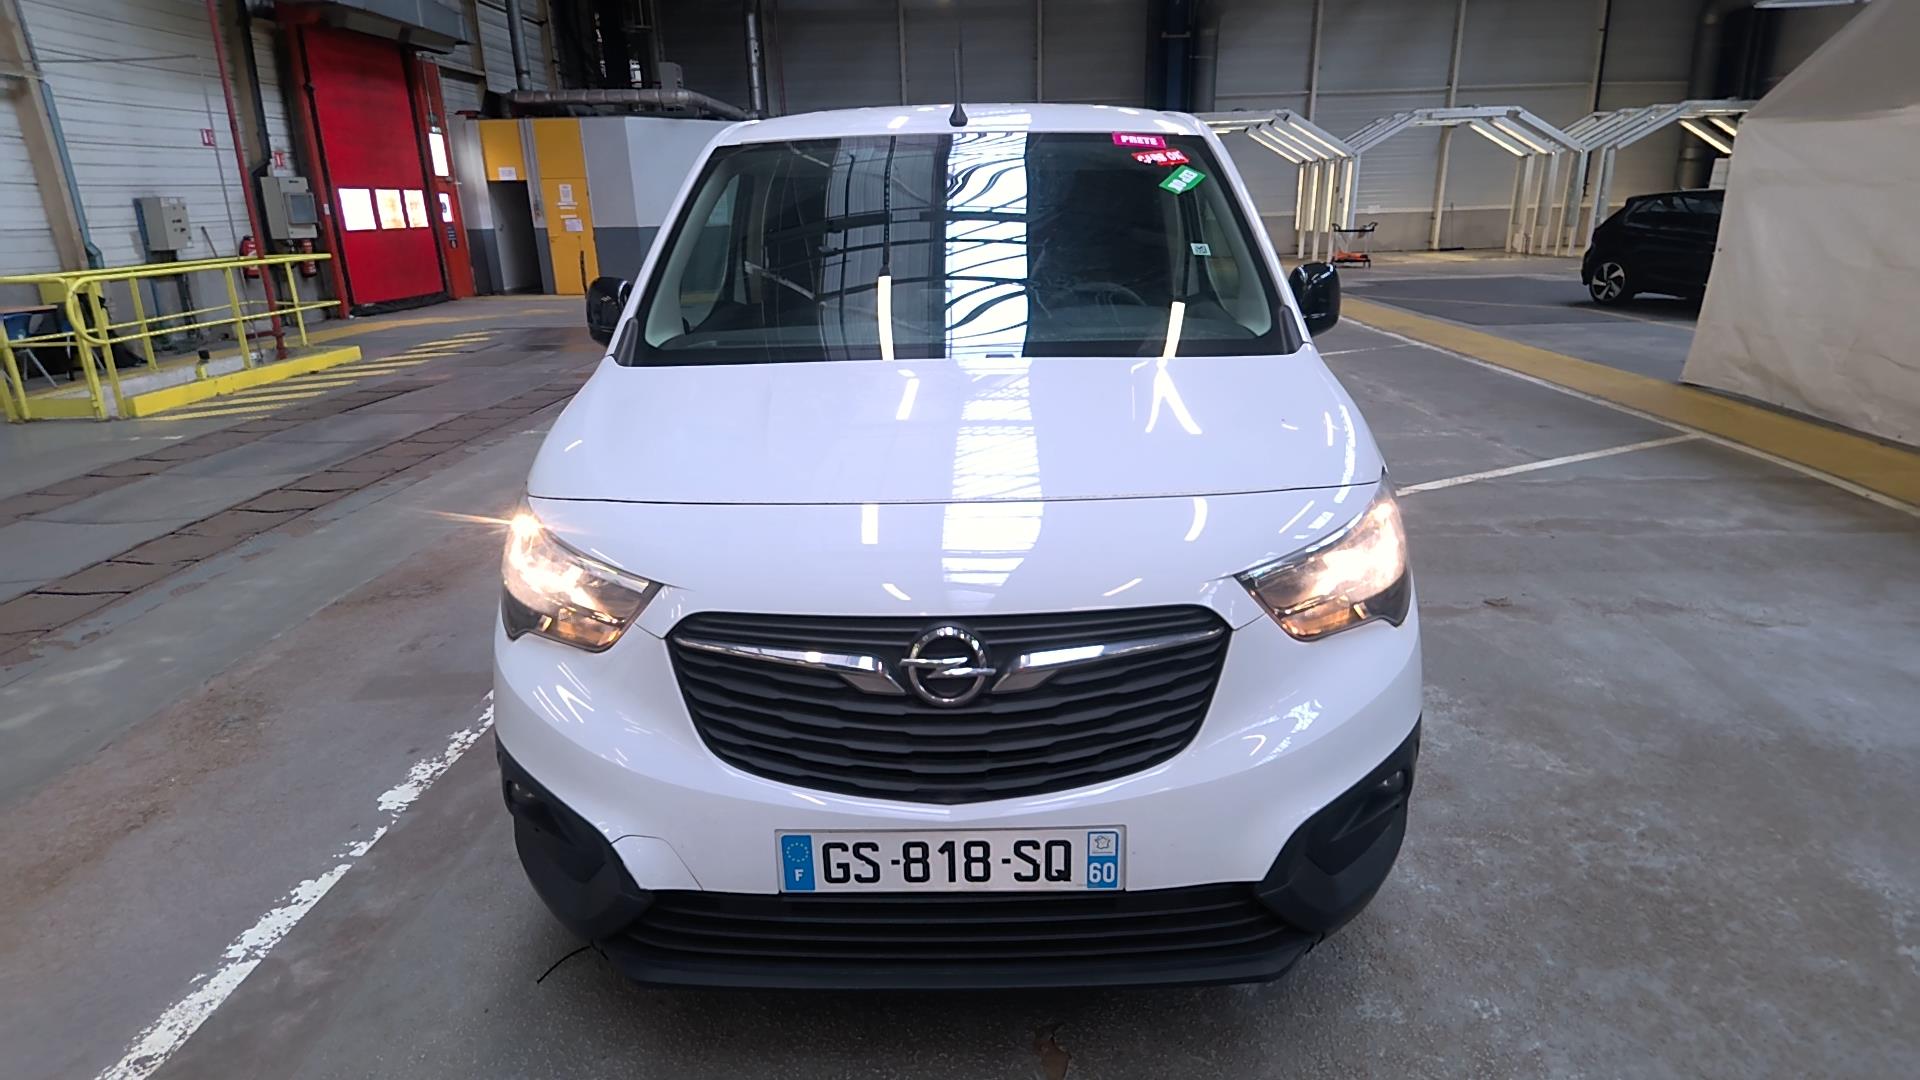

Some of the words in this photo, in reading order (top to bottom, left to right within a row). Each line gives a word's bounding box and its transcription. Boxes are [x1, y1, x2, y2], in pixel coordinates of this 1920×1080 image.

[794, 869, 805, 882] F
[821, 840, 1072, 884] GS-818-SQ
[1089, 862, 1116, 884] 60
